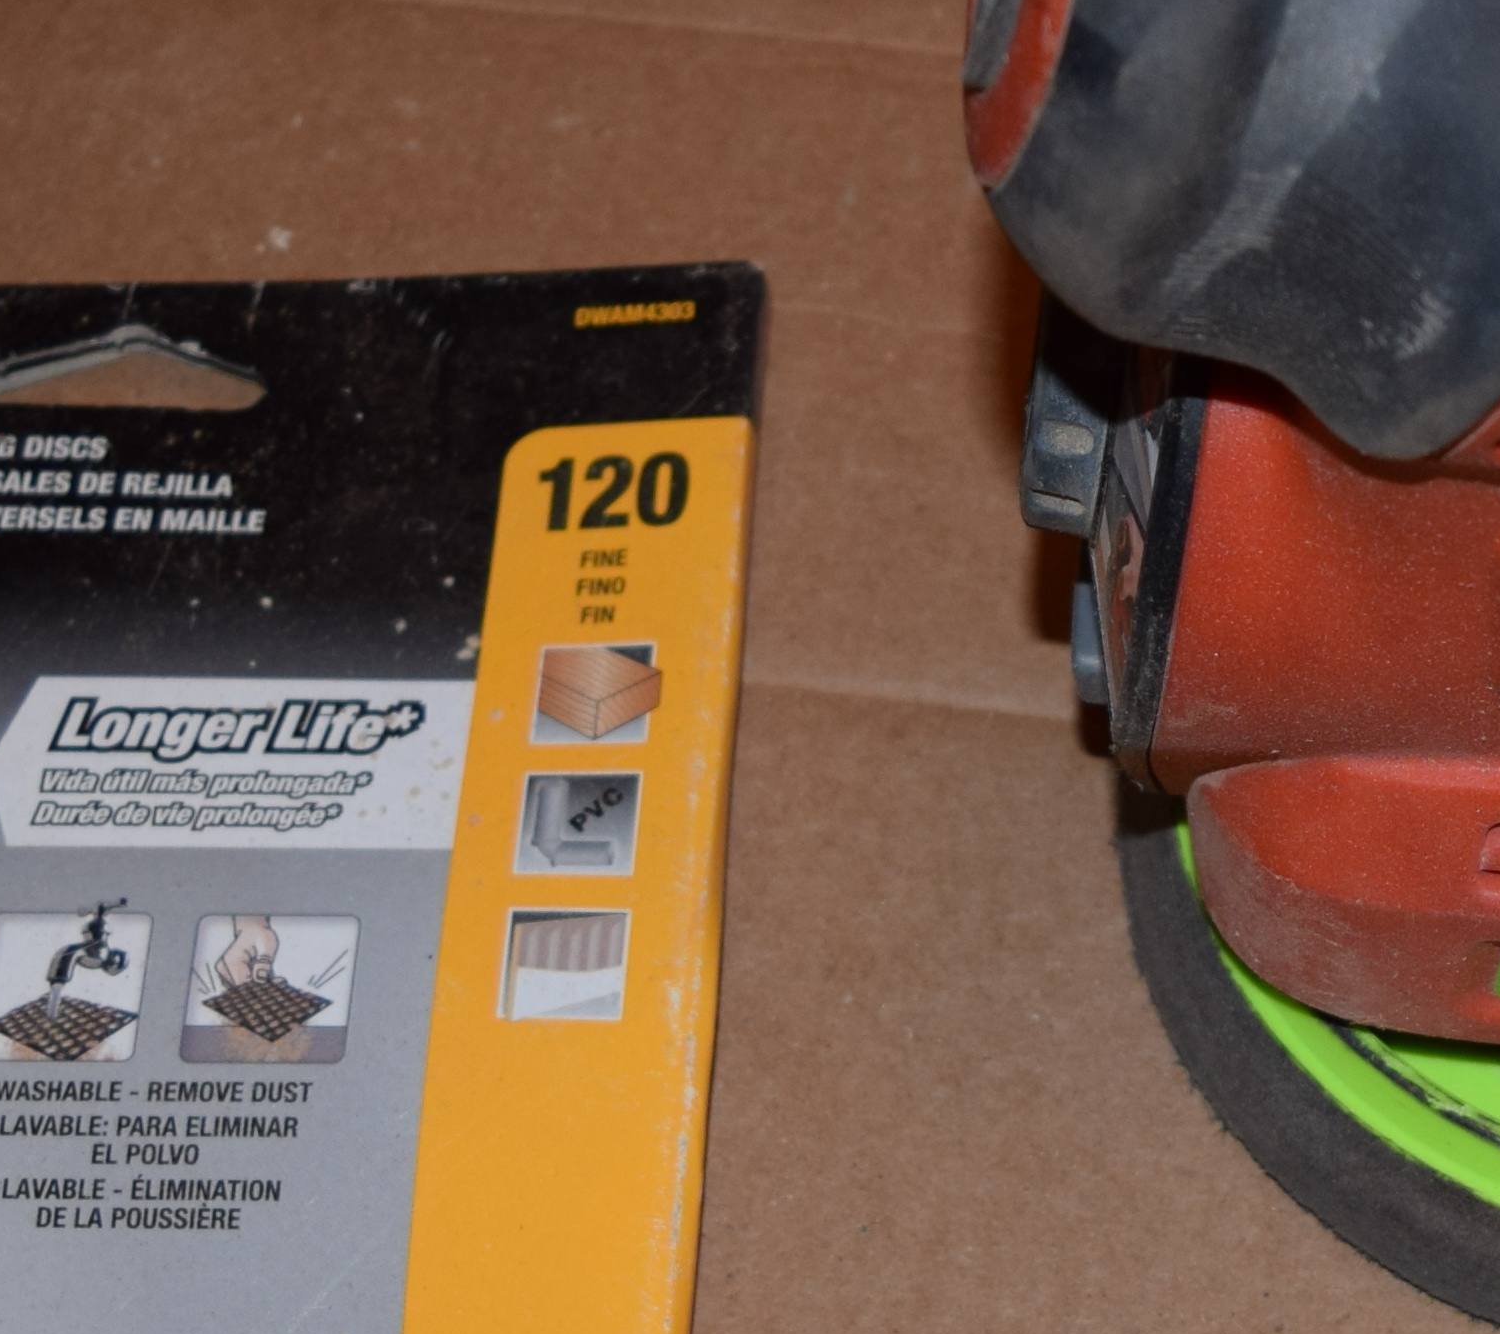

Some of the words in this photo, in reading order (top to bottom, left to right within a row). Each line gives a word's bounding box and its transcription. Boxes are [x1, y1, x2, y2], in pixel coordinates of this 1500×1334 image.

[23, 434, 108, 461] DISCS
[79, 471, 116, 496] DE
[122, 472, 234, 498] REJILLA
[539, 451, 690, 532] 120
[113, 508, 153, 532] EN
[159, 508, 266, 534] MAILLE
[579, 548, 628, 568] FINE
[575, 577, 626, 596] FINO
[580, 605, 616, 625] FIN
[49, 697, 272, 763] Longer
[40, 769, 100, 794] Vida
[101, 768, 149, 794] útil
[149, 769, 205, 794] más
[31, 800, 109, 826] Durée
[113, 801, 150, 826] de
[152, 802, 196, 826] vie
[569, 787, 624, 832] PVC
[146, 1081, 244, 1103] REMOVE
[251, 1081, 314, 1103] DUST
[0, 1115, 109, 1137] LAVABLE:
[116, 1116, 178, 1137] PARA
[185, 1116, 299, 1138] ELIMINAR
[91, 1143, 119, 1164] EL
[125, 1143, 200, 1165] POLVO
[1, 1178, 106, 1200] LAVABLE
[130, 1173, 282, 1201] ÉLIMINATION
[35, 1207, 67, 1228] DE
[73, 1207, 103, 1229] LA
[110, 1202, 242, 1230] POUSSIÈRE
